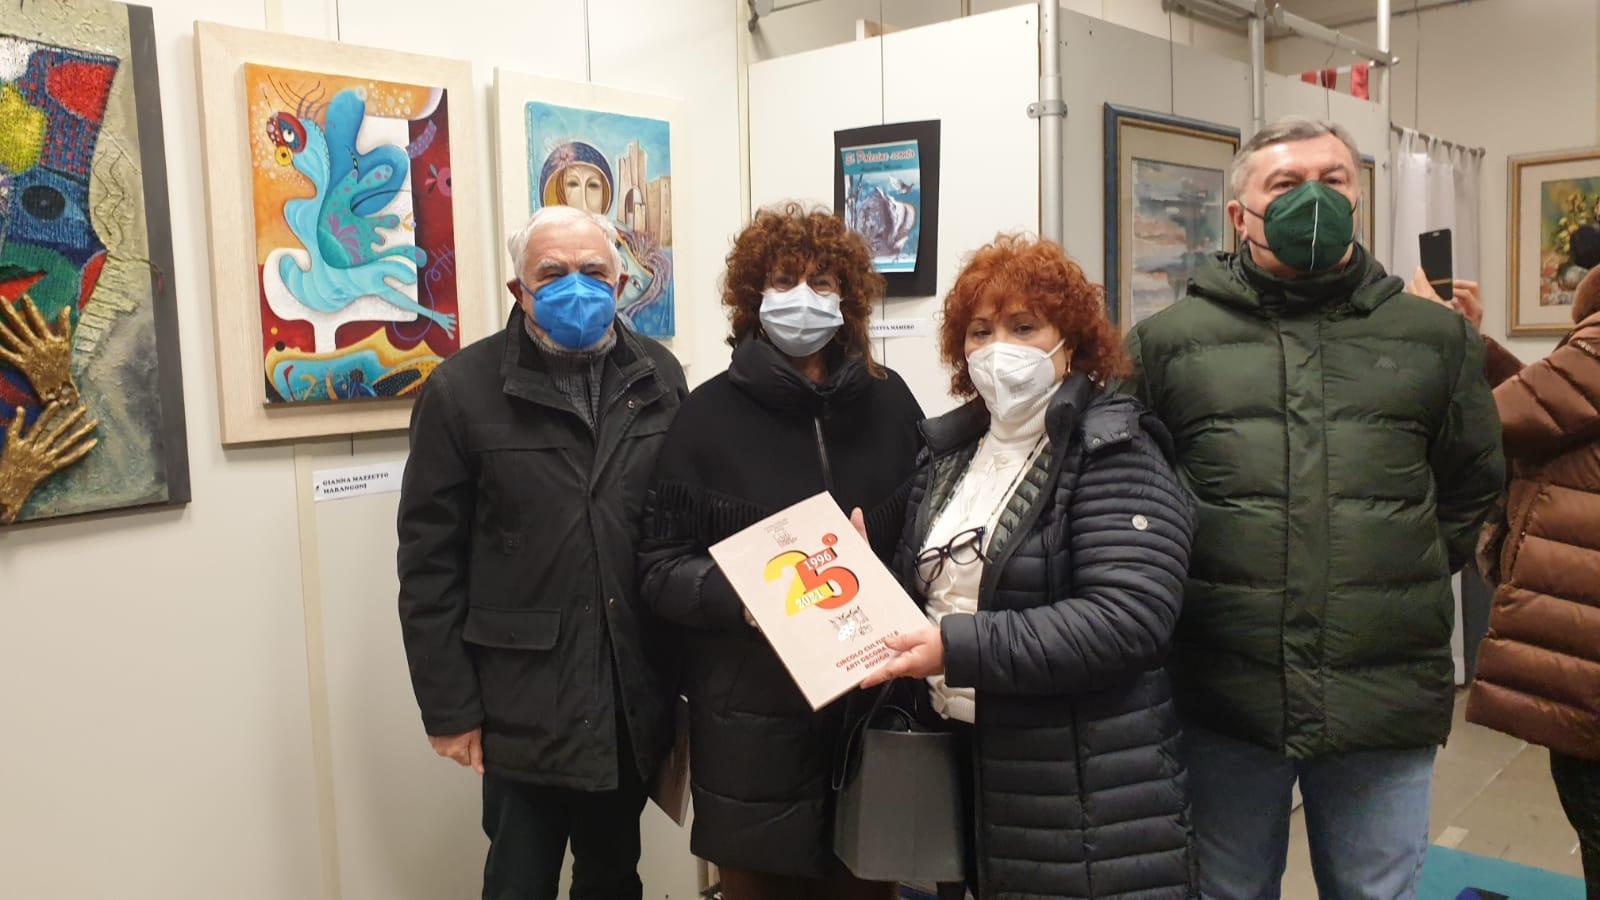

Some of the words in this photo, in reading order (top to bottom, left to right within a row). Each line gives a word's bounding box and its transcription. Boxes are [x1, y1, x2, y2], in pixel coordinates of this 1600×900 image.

[322, 477, 351, 486] GIANNA
[352, 472, 389, 482] MAZZETTO
[323, 483, 367, 494] MARANGONI
[804, 551, 832, 570] 1996
[795, 589, 824, 608] 2021
[835, 650, 863, 668] CIRCOLO
[846, 660, 860, 672] ARTI
[860, 646, 887, 662] DECORA
[864, 653, 890, 669] ROVIGO
